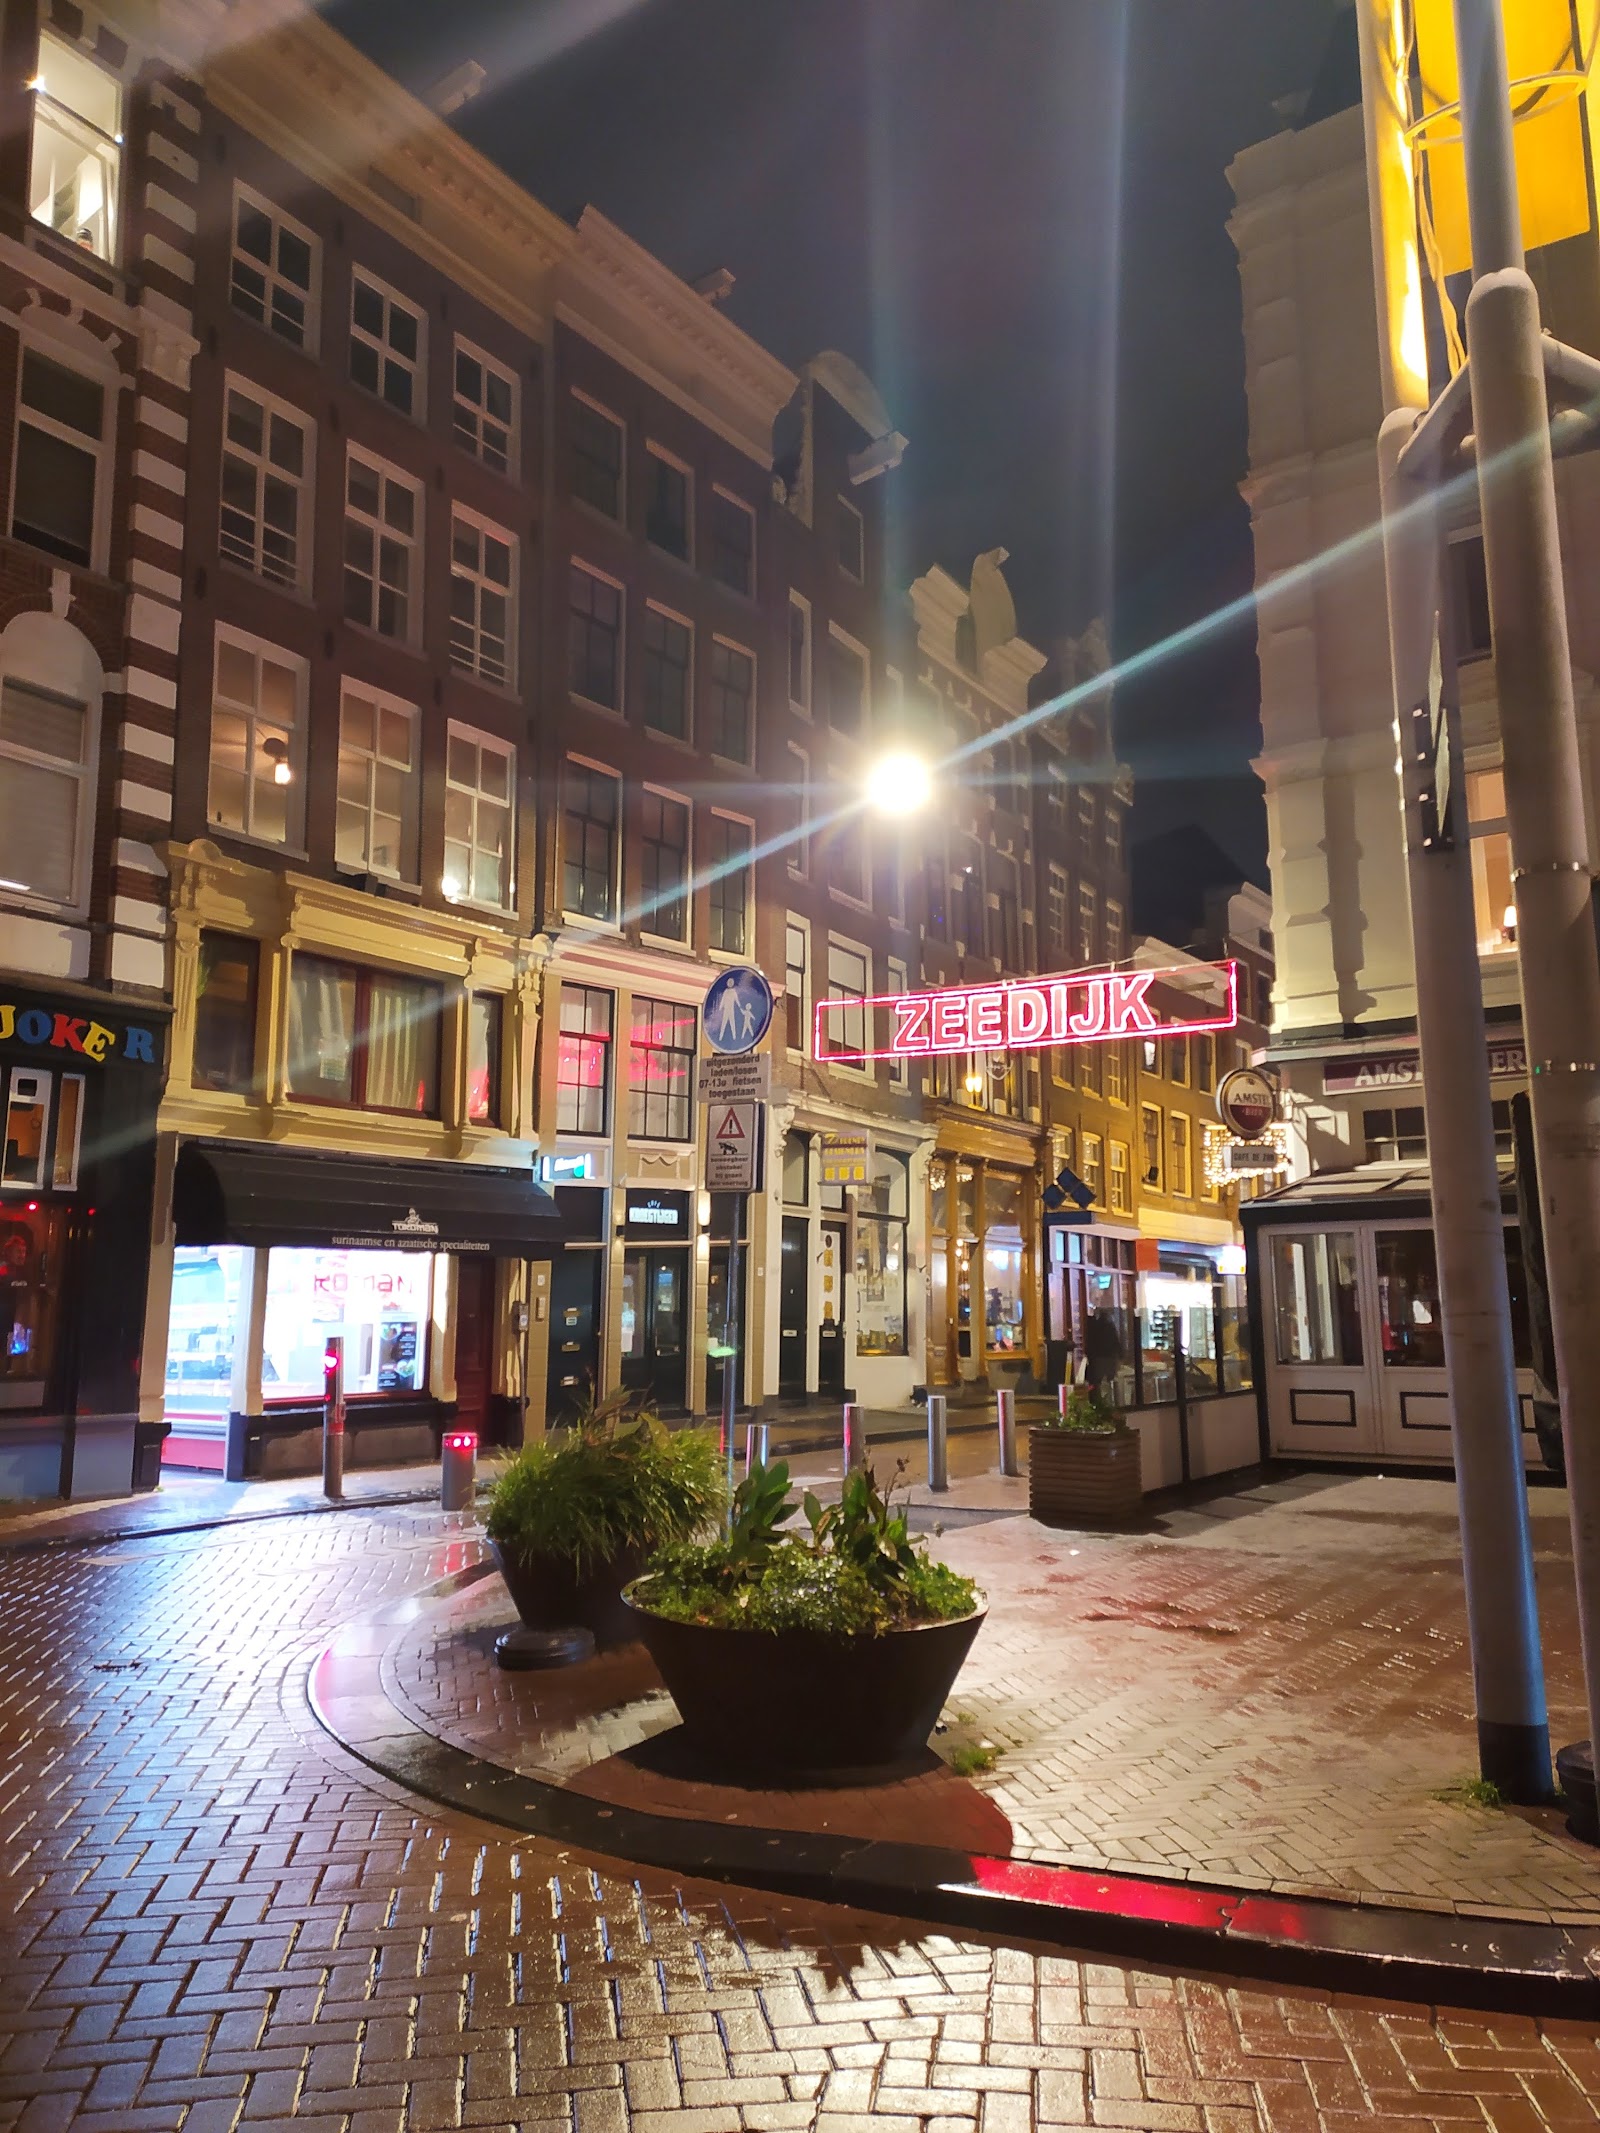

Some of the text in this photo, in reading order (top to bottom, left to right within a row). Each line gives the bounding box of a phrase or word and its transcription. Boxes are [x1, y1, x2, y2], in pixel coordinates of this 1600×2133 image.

[892, 973, 1157, 1053] ZEEDIJK
[0, 1004, 155, 1063] JOKER
[706, 1053, 760, 1068] uitgezonderd
[1354, 1049, 1528, 1087] AMST ER
[732, 1077, 762, 1086] fietsen
[708, 1088, 756, 1100] toegestaan
[331, 1235, 490, 1252] surinaamse en aziatische specialiteiten
